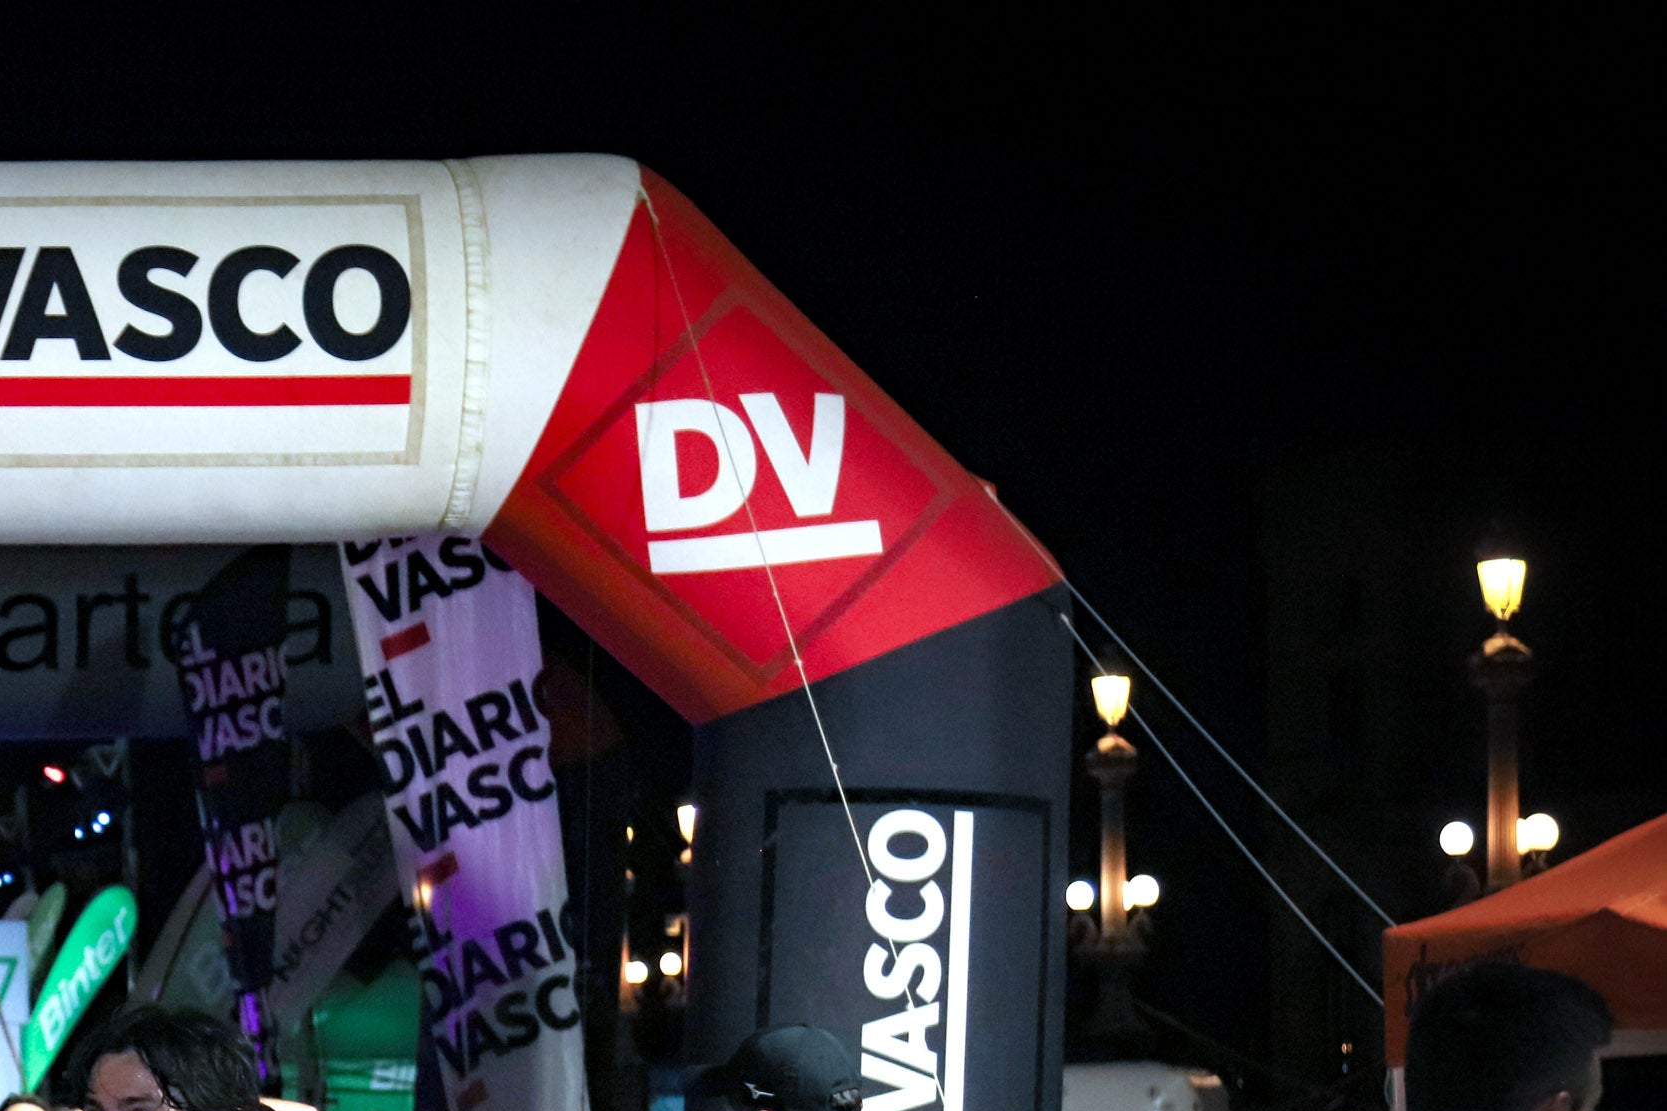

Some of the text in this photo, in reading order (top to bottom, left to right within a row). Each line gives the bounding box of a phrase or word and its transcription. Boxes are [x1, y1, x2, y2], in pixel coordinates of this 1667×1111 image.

[634, 392, 846, 533] DV
[381, 678, 549, 798] DIARI
[393, 744, 556, 853] VASC
[37, 905, 129, 1052] Binter
[423, 908, 574, 1025] DIARI
[435, 975, 580, 1078] VASC
